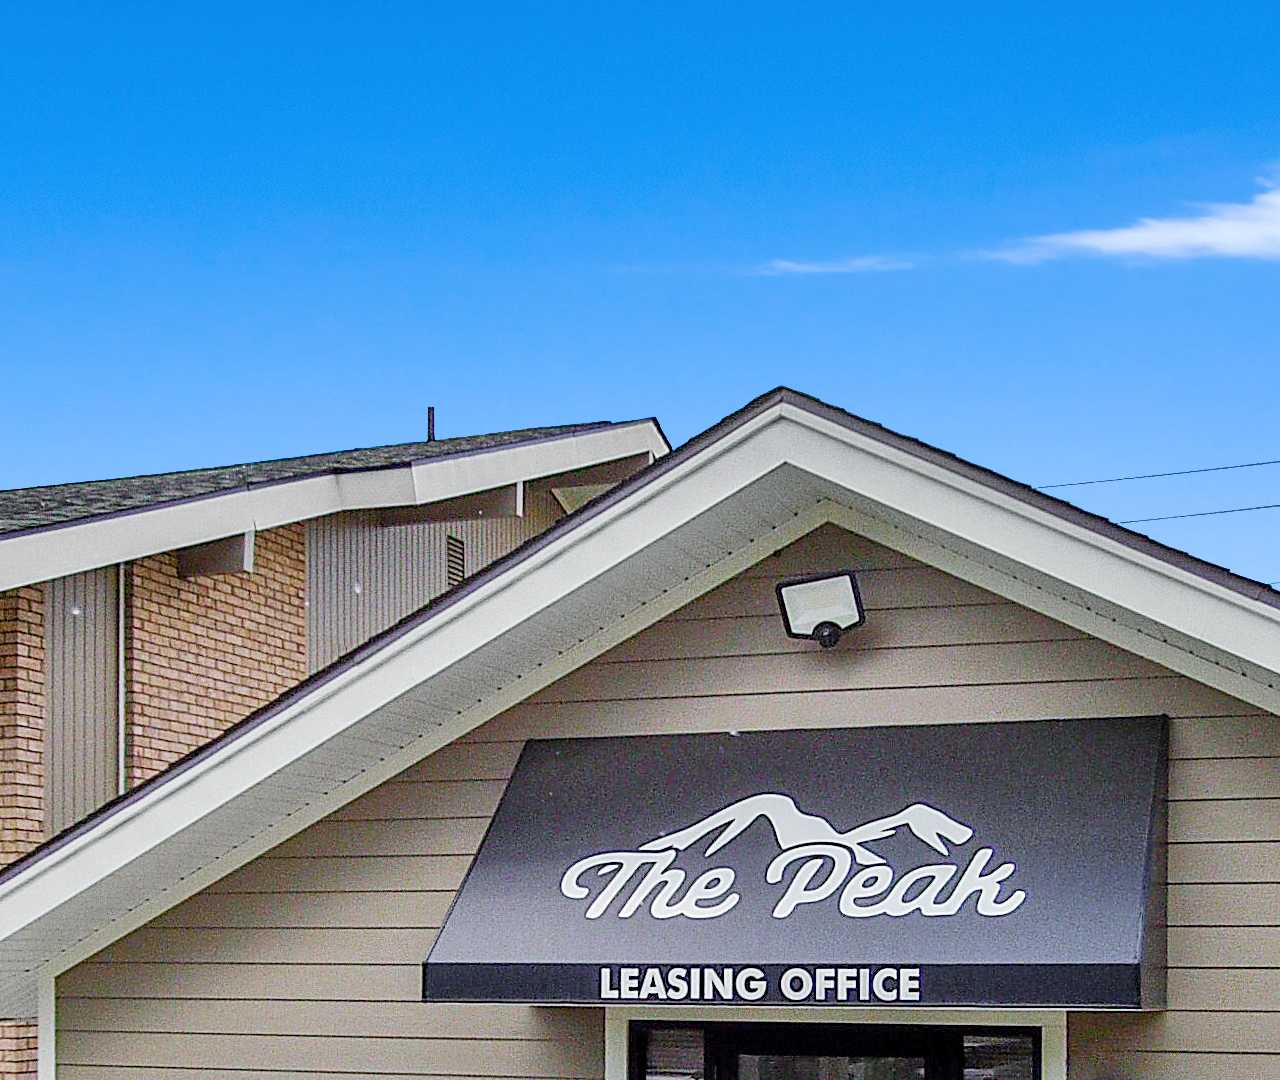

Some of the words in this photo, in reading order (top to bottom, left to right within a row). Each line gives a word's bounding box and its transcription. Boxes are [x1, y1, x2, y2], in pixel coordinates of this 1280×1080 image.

[560, 846, 741, 919] The
[766, 842, 1026, 919] Peak
[599, 967, 767, 1001] LEASING
[780, 967, 921, 1002] OFFICE
